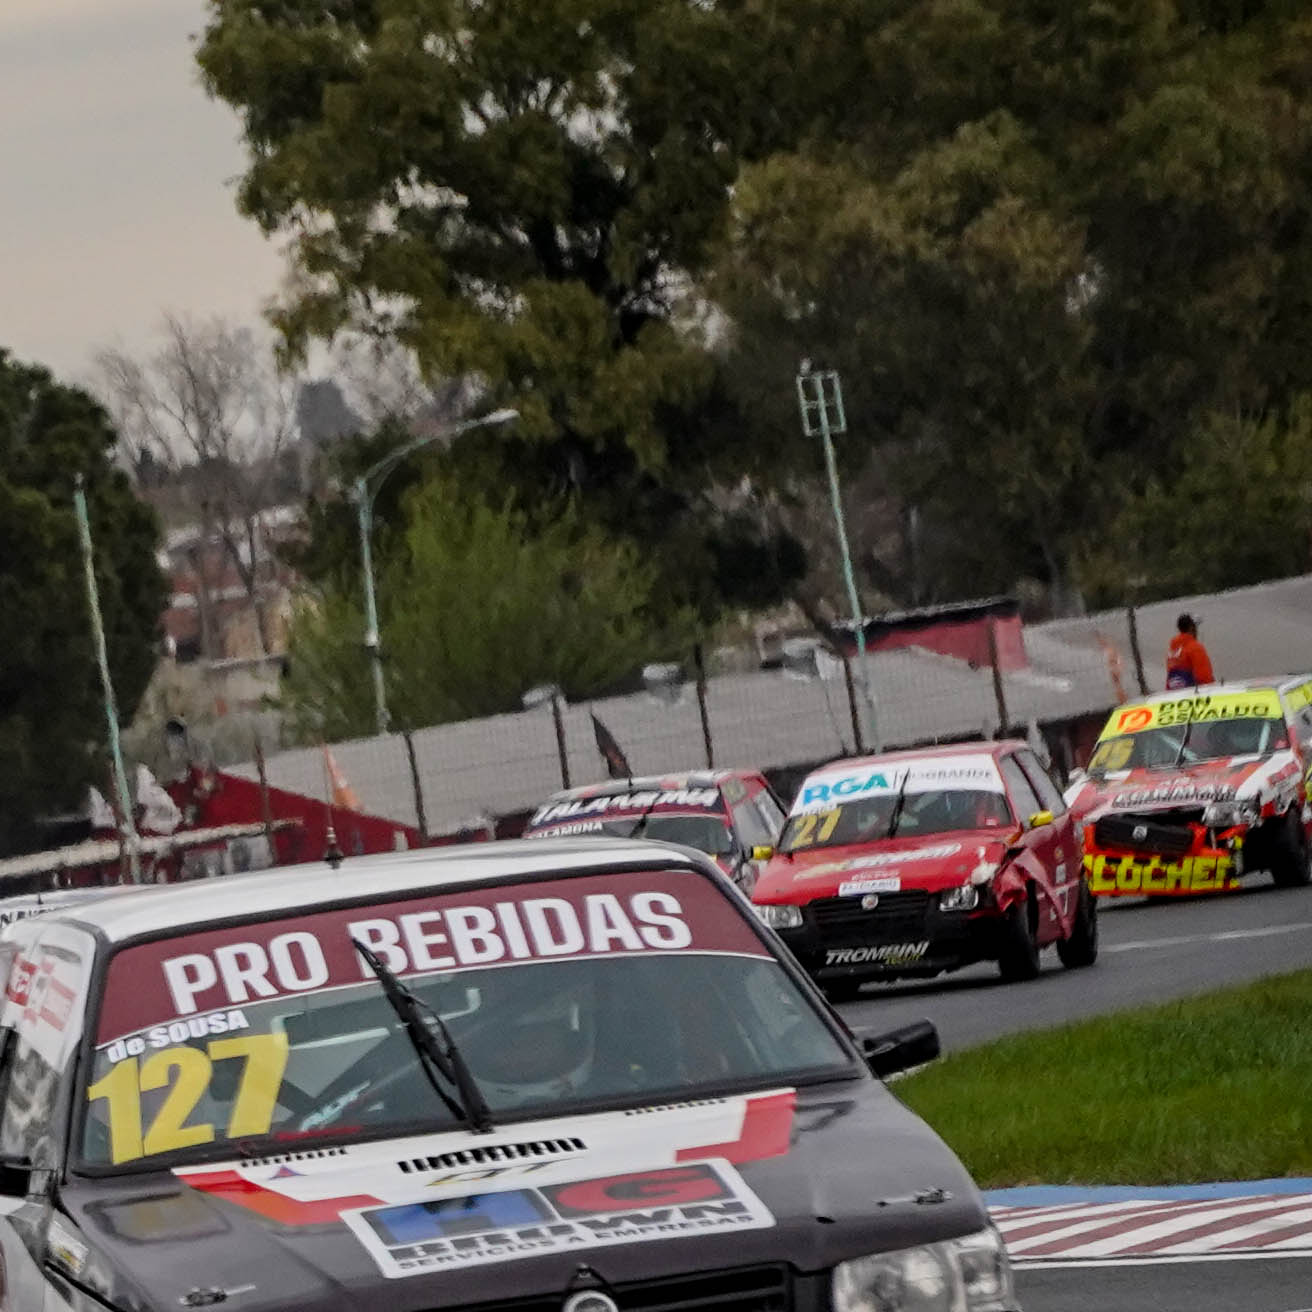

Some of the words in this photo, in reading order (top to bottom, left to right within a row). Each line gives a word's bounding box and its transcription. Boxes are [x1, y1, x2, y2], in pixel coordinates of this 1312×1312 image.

[1157, 704, 1269, 726] OSVALDO
[1159, 695, 1211, 713] DON
[802, 772, 890, 805] RGA
[161, 930, 331, 1016] PRO
[348, 892, 693, 979] BEBIDAS
[107, 1034, 146, 1063] de
[148, 1008, 249, 1047] SOUSA
[87, 1031, 291, 1166] 127
[399, 1241, 559, 1269] SERVICIOS
[568, 1234, 587, 1246] A
[595, 1213, 754, 1240] EMPRESAS
